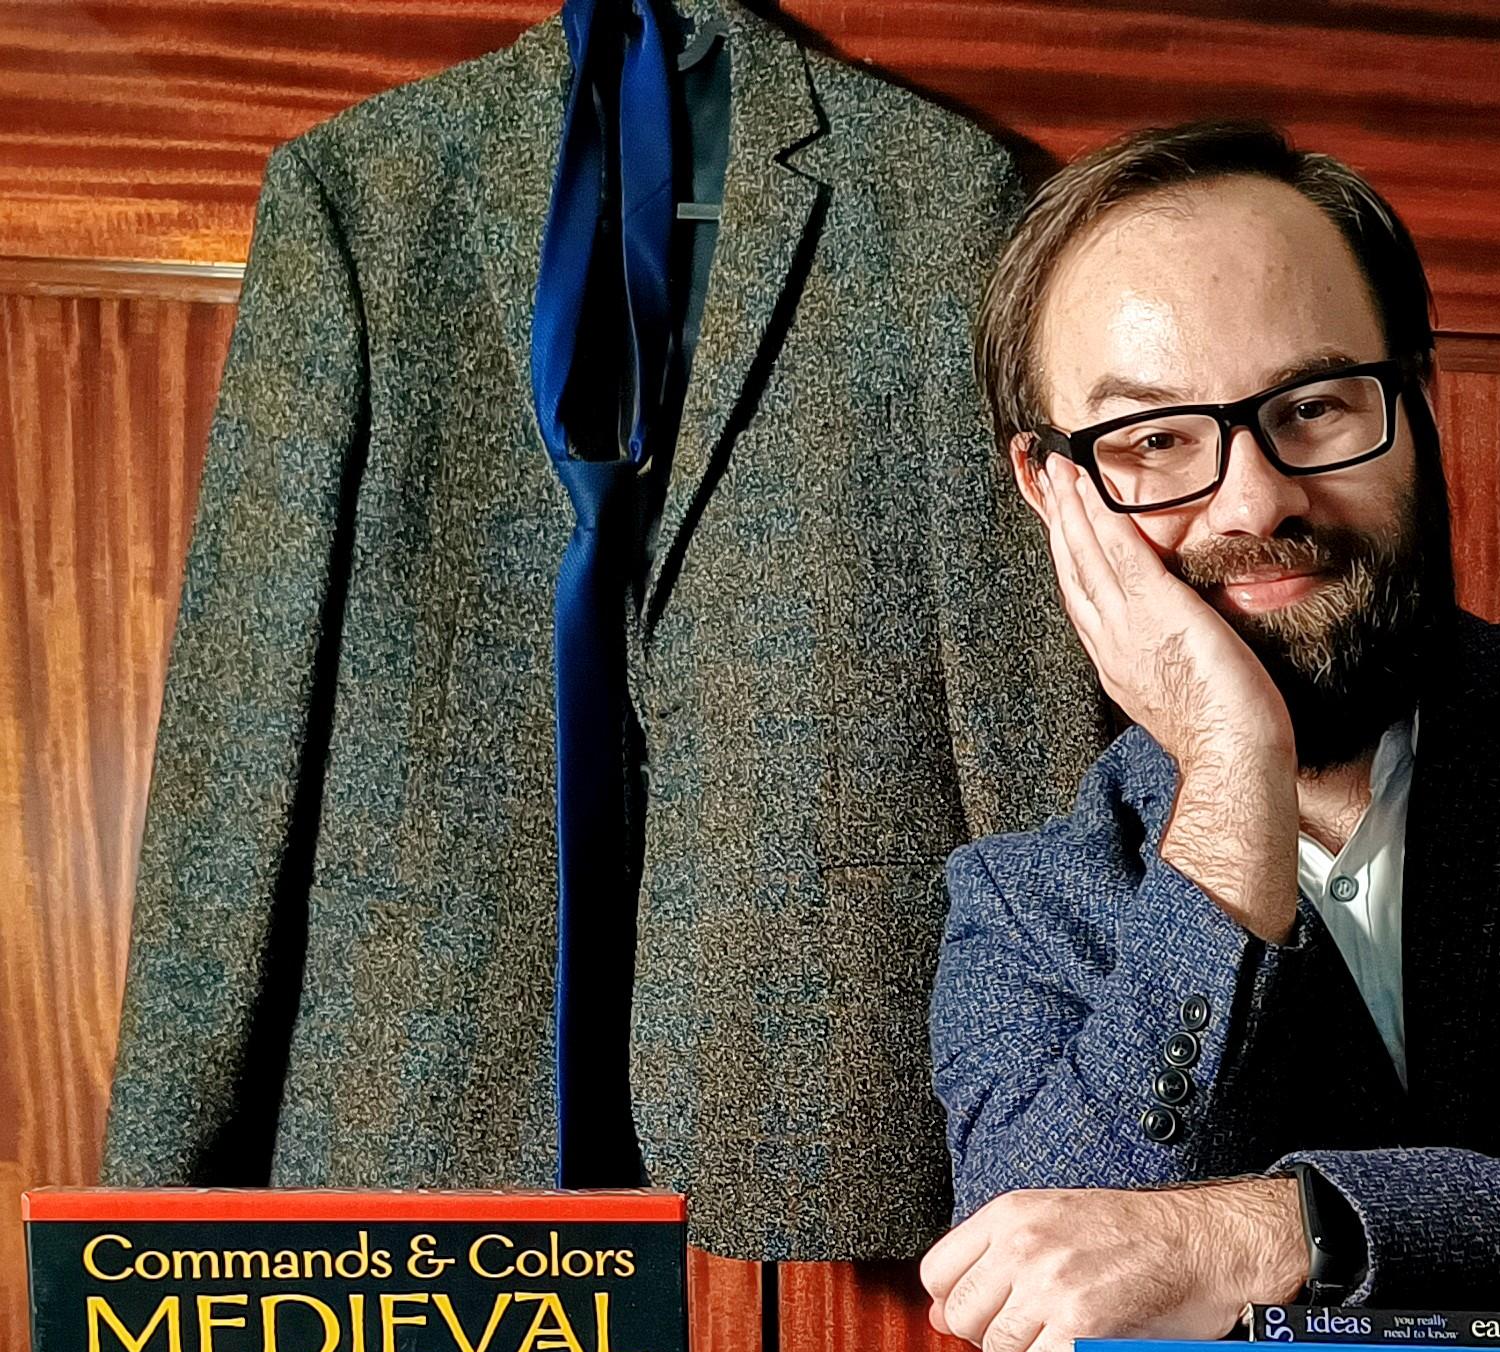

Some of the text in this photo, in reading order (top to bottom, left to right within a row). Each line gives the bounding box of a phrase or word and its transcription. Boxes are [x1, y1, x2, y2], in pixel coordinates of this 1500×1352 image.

[83, 1230, 635, 1281] Commands & Colors
[1266, 1306, 1293, 1342] 50
[1306, 1308, 1371, 1334] ideas
[1394, 1315, 1448, 1327] you really
[1384, 1329, 1458, 1340] need to know
